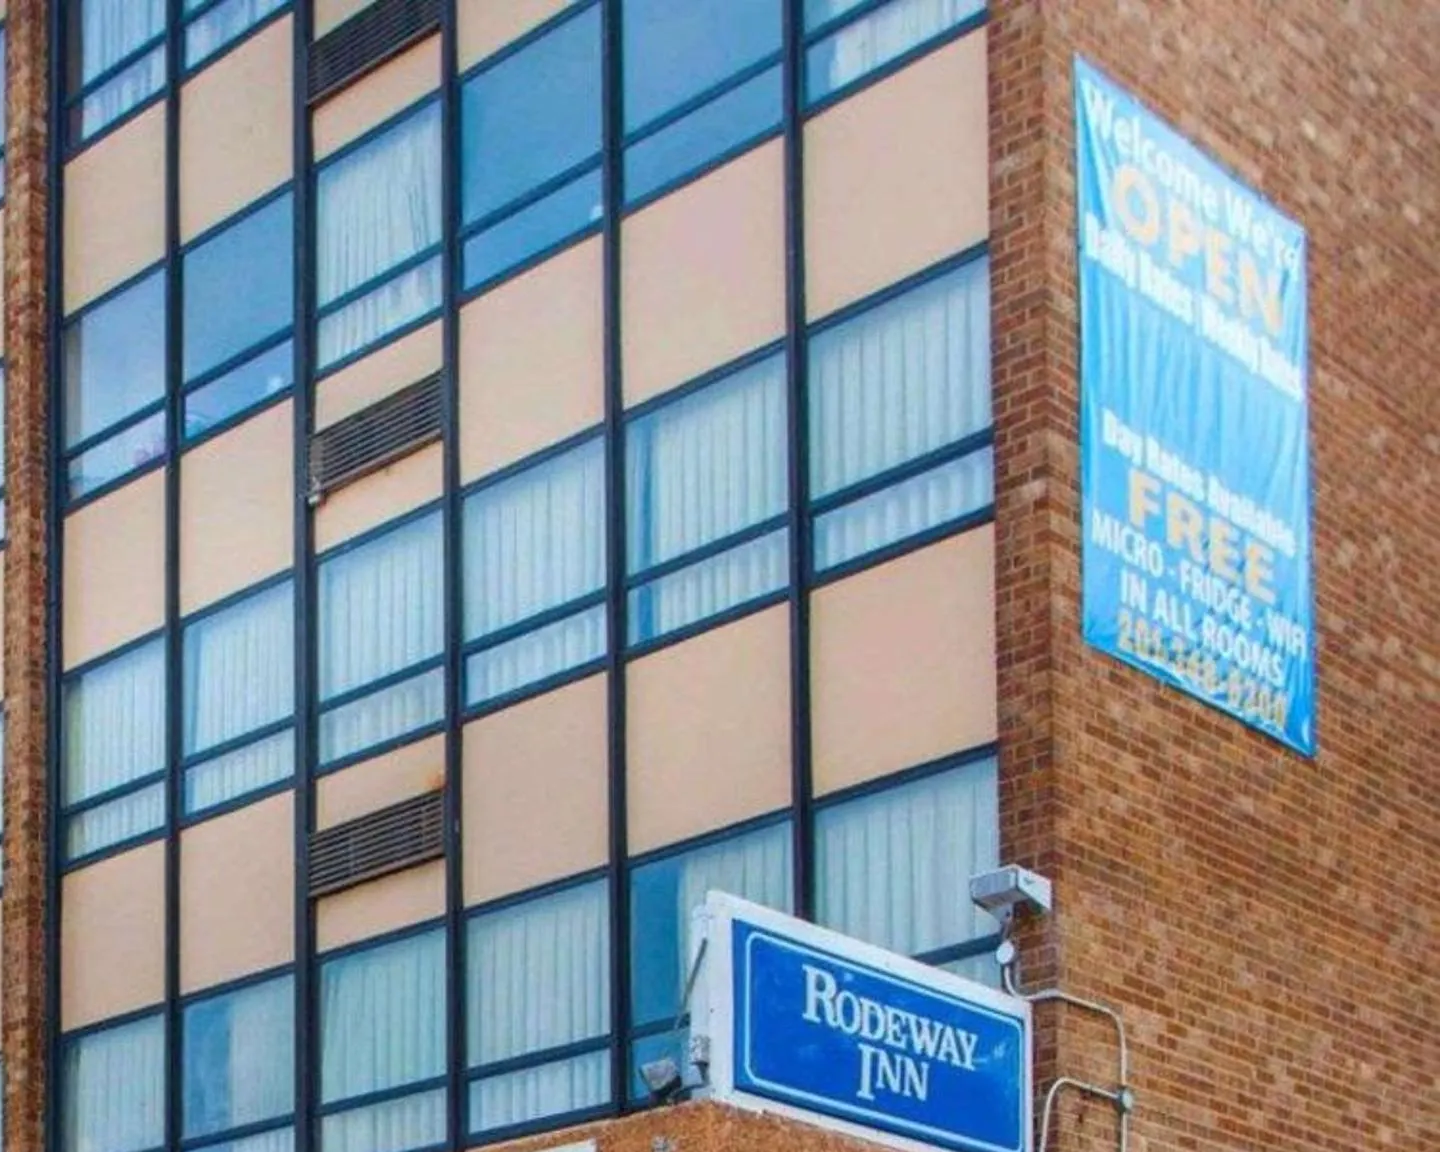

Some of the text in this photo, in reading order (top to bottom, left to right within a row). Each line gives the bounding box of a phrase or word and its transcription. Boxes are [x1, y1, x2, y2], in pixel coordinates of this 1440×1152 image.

[1081, 80, 1219, 222] Welcome
[1114, 162, 1282, 334] OPEN
[1092, 508, 1163, 578] MICRO
[1180, 559, 1251, 628] FRIDGE
[1129, 466, 1275, 605] FREE
[1120, 570, 1282, 687] IN ALL ROOMS
[801, 963, 978, 1071] RODEWAY
[856, 1043, 930, 1101] INN
